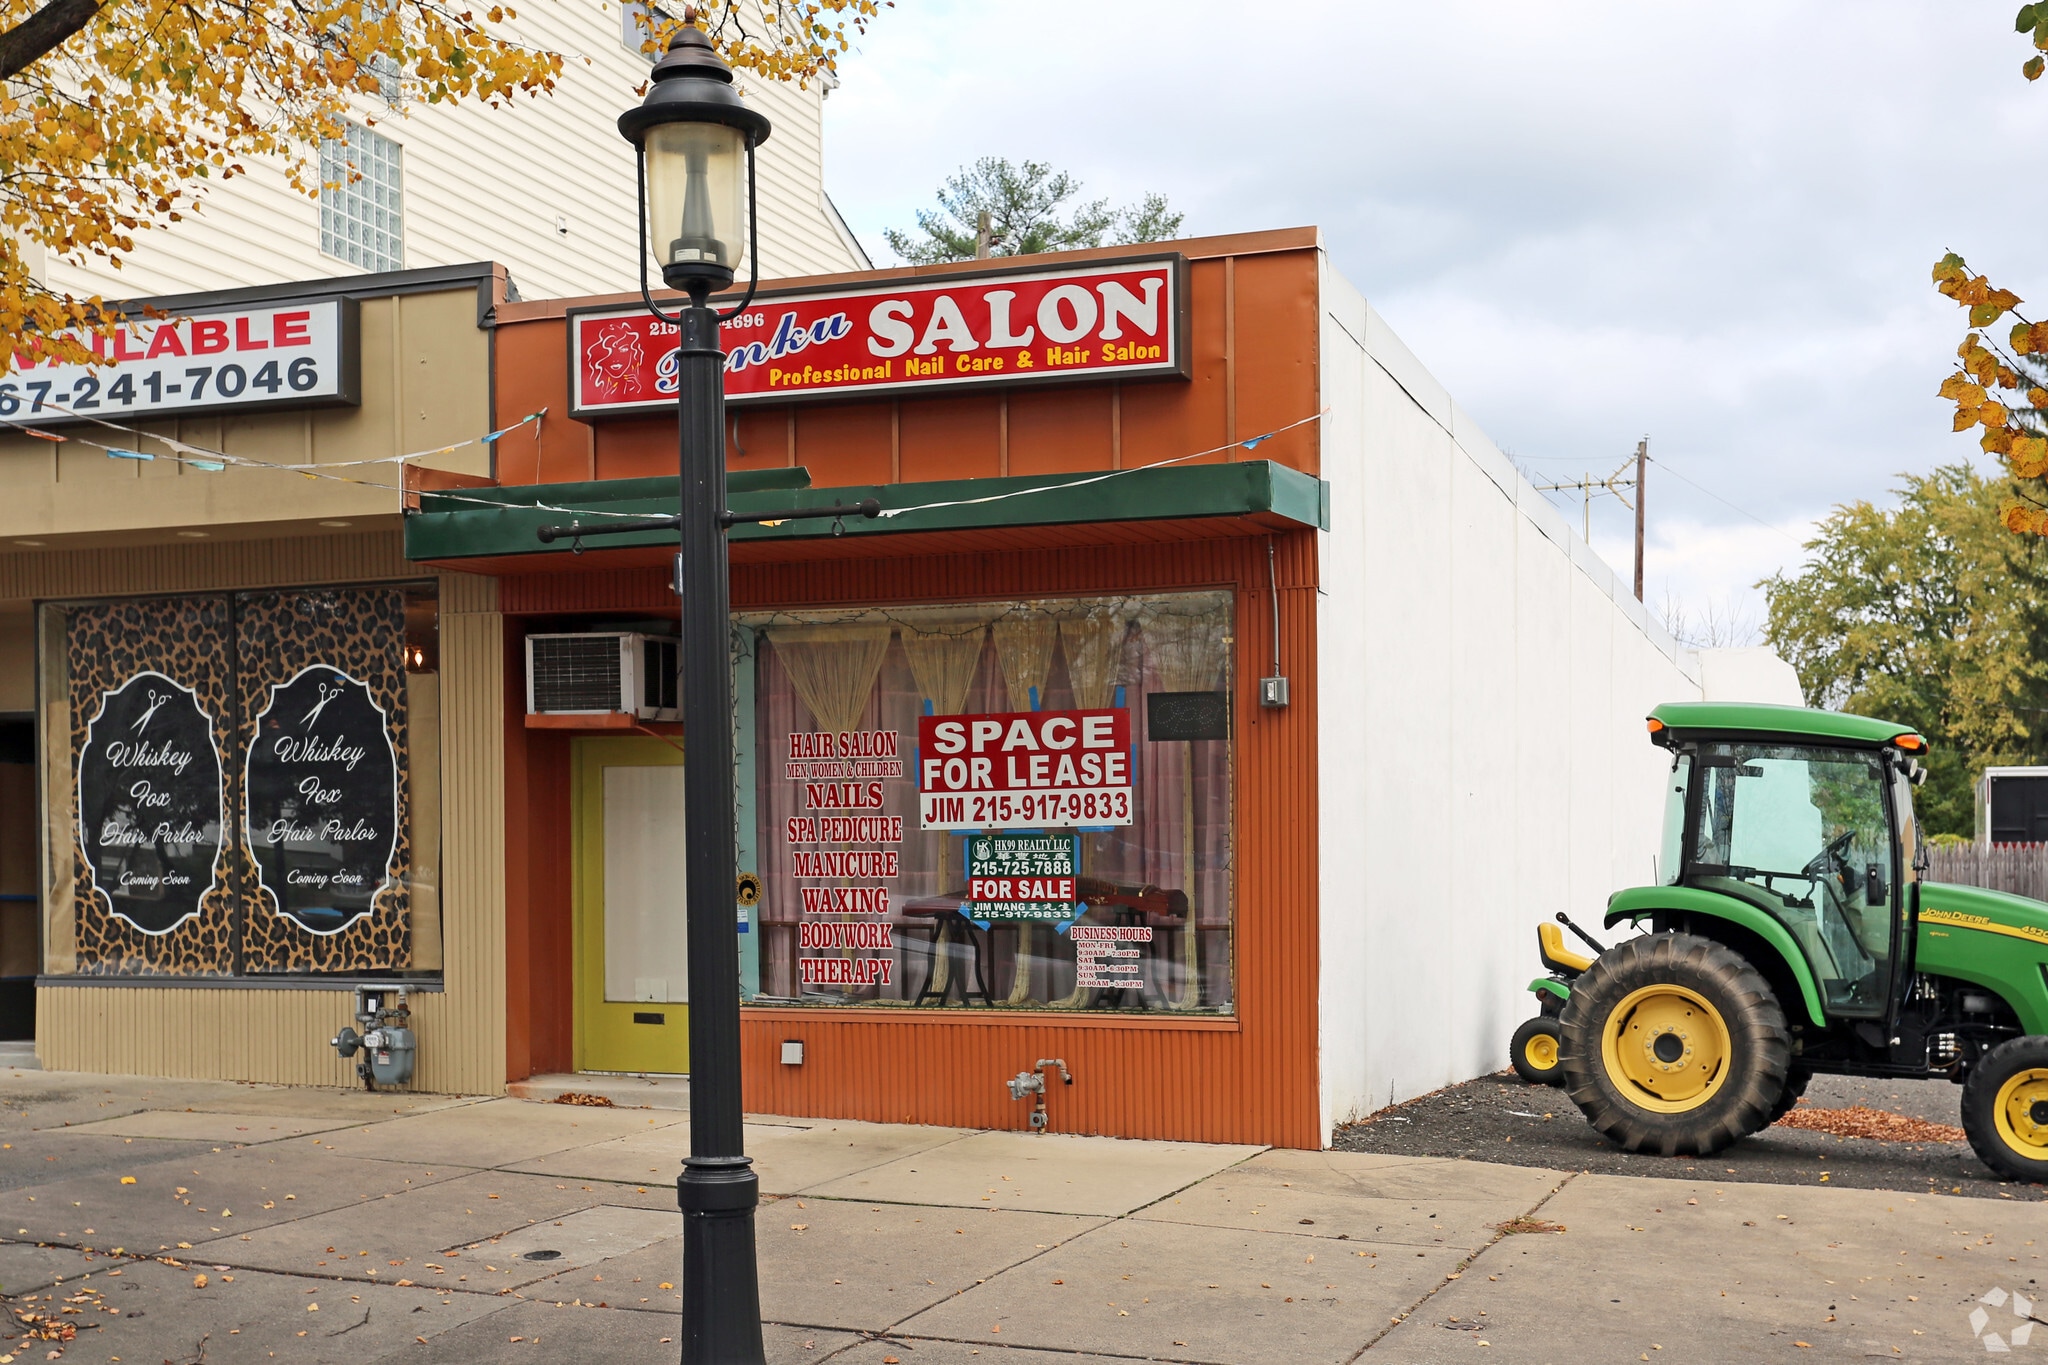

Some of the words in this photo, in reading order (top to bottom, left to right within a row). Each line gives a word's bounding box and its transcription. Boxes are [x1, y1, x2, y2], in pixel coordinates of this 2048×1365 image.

[867, 277, 1163, 358] SALON
[769, 360, 891, 386] Professional
[905, 355, 944, 377] Nail
[956, 353, 1003, 374] Care
[1016, 349, 1034, 368] &
[1047, 346, 1090, 366] Hair
[1102, 342, 1161, 363] Salon
[789, 732, 835, 758] HAIR
[839, 731, 897, 758] SALON
[933, 715, 1115, 754] SPACE
[106, 740, 192, 776] Whiskey
[274, 734, 365, 771] Whiskey
[786, 763, 809, 780] MEN,
[810, 762, 844, 778] WOMEN
[847, 762, 853, 778] &
[855, 761, 903, 778] CHILDREN
[923, 756, 994, 790] FOR
[1007, 752, 1127, 787] LEASE
[130, 780, 171, 808] Fox
[299, 776, 342, 805] Fox
[805, 782, 884, 809] NAILS
[925, 797, 964, 823] JIM
[972, 792, 1128, 821] 215-917-9833
[100, 821, 147, 846] Hair
[152, 821, 205, 844] Parlor
[267, 818, 315, 843] Hair
[320, 818, 377, 841] Parlor
[787, 817, 817, 843] SPA
[820, 816, 903, 843] PEDICURE
[995, 840, 1016, 851] HK99
[1018, 840, 1052, 851] REALTY
[1053, 839, 1071, 850] LLC
[793, 850, 899, 878] MANICURE
[972, 861, 1072, 875] 215-725-7888
[120, 871, 159, 890] Coming
[162, 870, 191, 886] Soon
[287, 869, 329, 889] Coming
[332, 868, 363, 884] Soon
[972, 880, 1012, 899] FOR
[1018, 880, 1072, 899] SALE
[801, 887, 889, 914] WAXING
[974, 902, 991, 911] JIM
[994, 902, 1025, 911] WANG
[1921, 907, 1952, 919] JOHN
[1952, 911, 1990, 925] DEERE
[800, 922, 893, 949] BODYWORK
[1071, 926, 1117, 940] BUSINESS
[1119, 927, 1152, 941] HOURS
[800, 958, 893, 985] THERAPY
